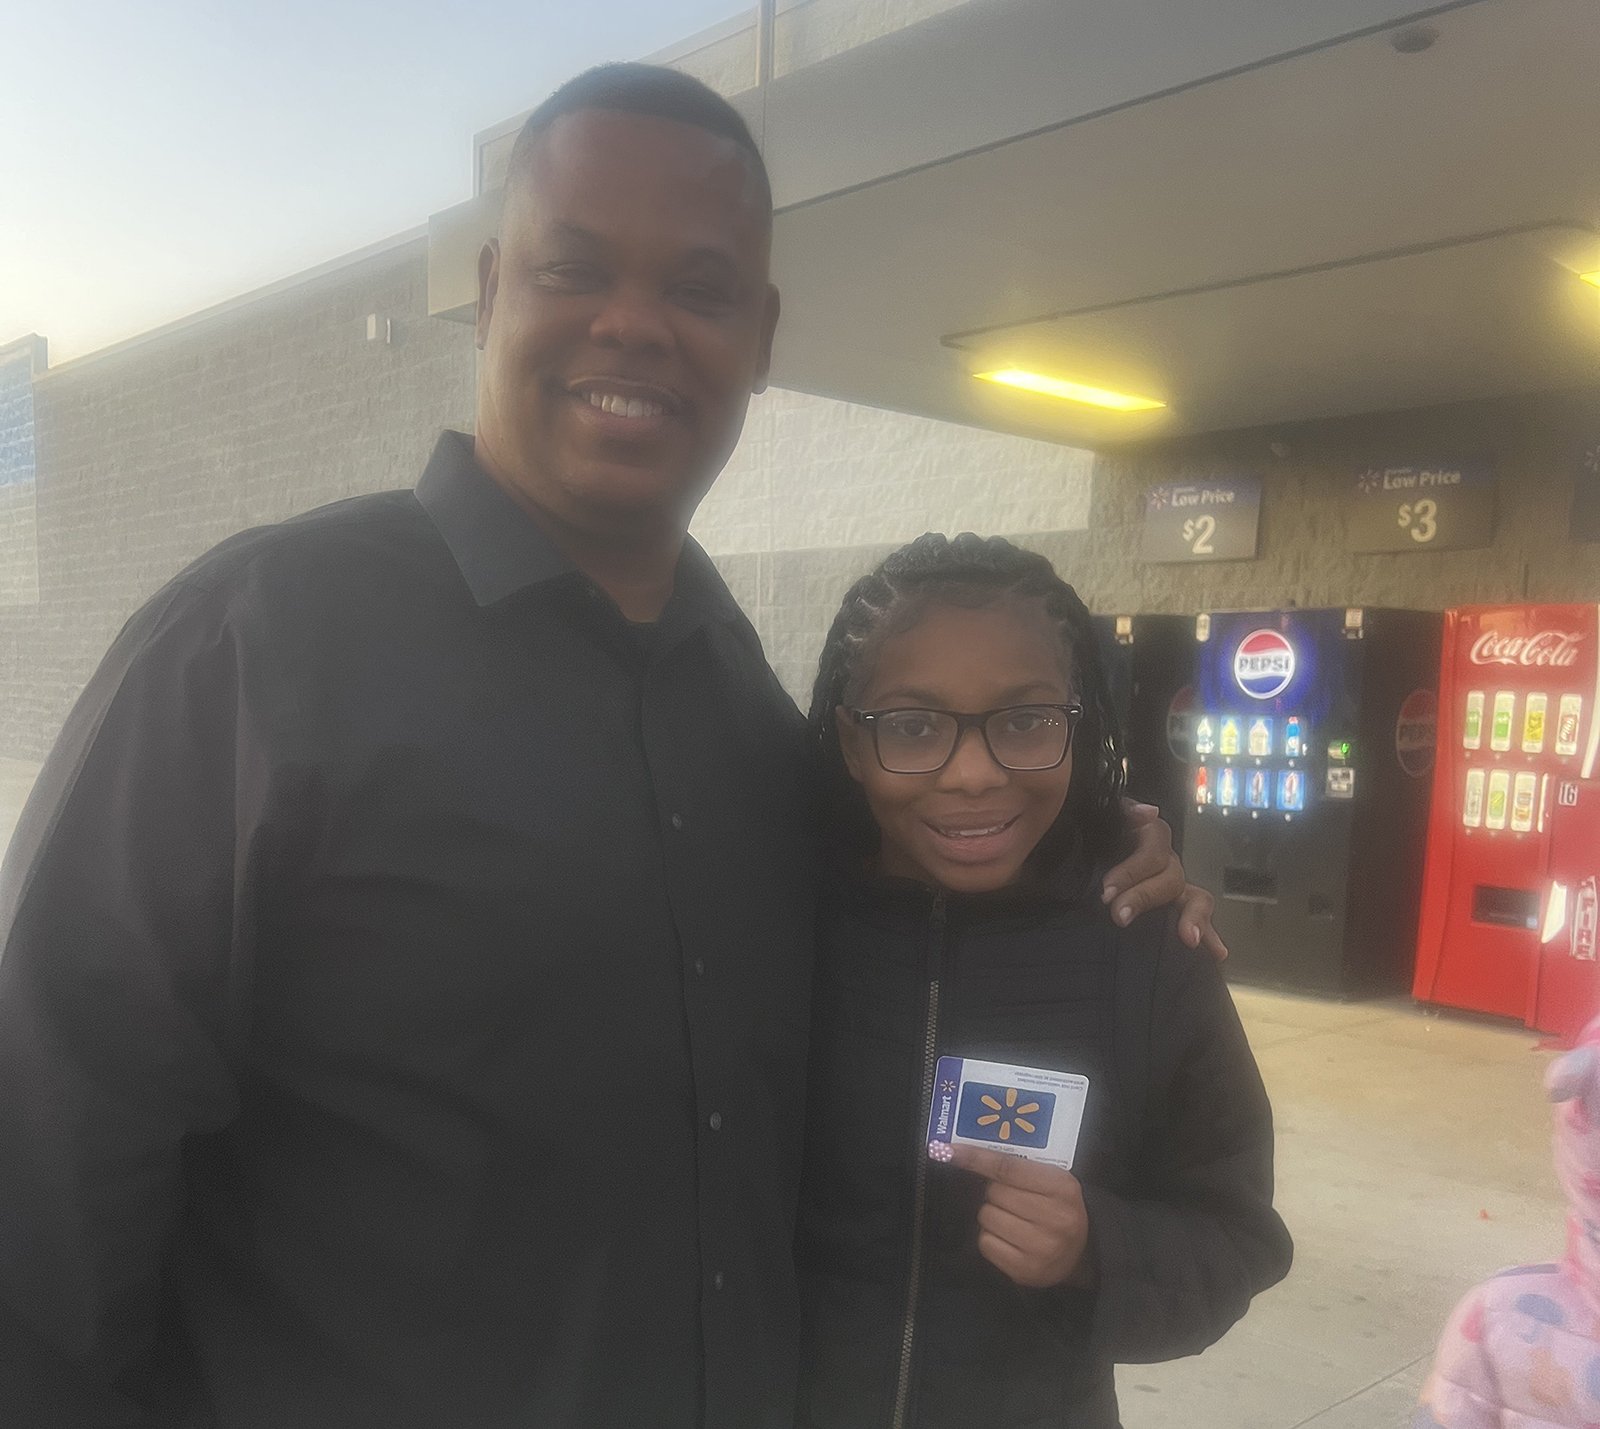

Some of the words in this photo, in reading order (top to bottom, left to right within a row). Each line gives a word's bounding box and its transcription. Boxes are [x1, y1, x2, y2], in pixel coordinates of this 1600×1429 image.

[1383, 474, 1417, 490] Low
[1420, 470, 1461, 486] Price
[1171, 492, 1200, 507] Low
[1201, 489, 1235, 504] Price
[1398, 500, 1437, 542] $3
[1182, 514, 1216, 554] $2
[1239, 656, 1289, 672] PEPSI
[1561, 783, 1577, 805] 16
[936, 1095, 952, 1134] Walmart
